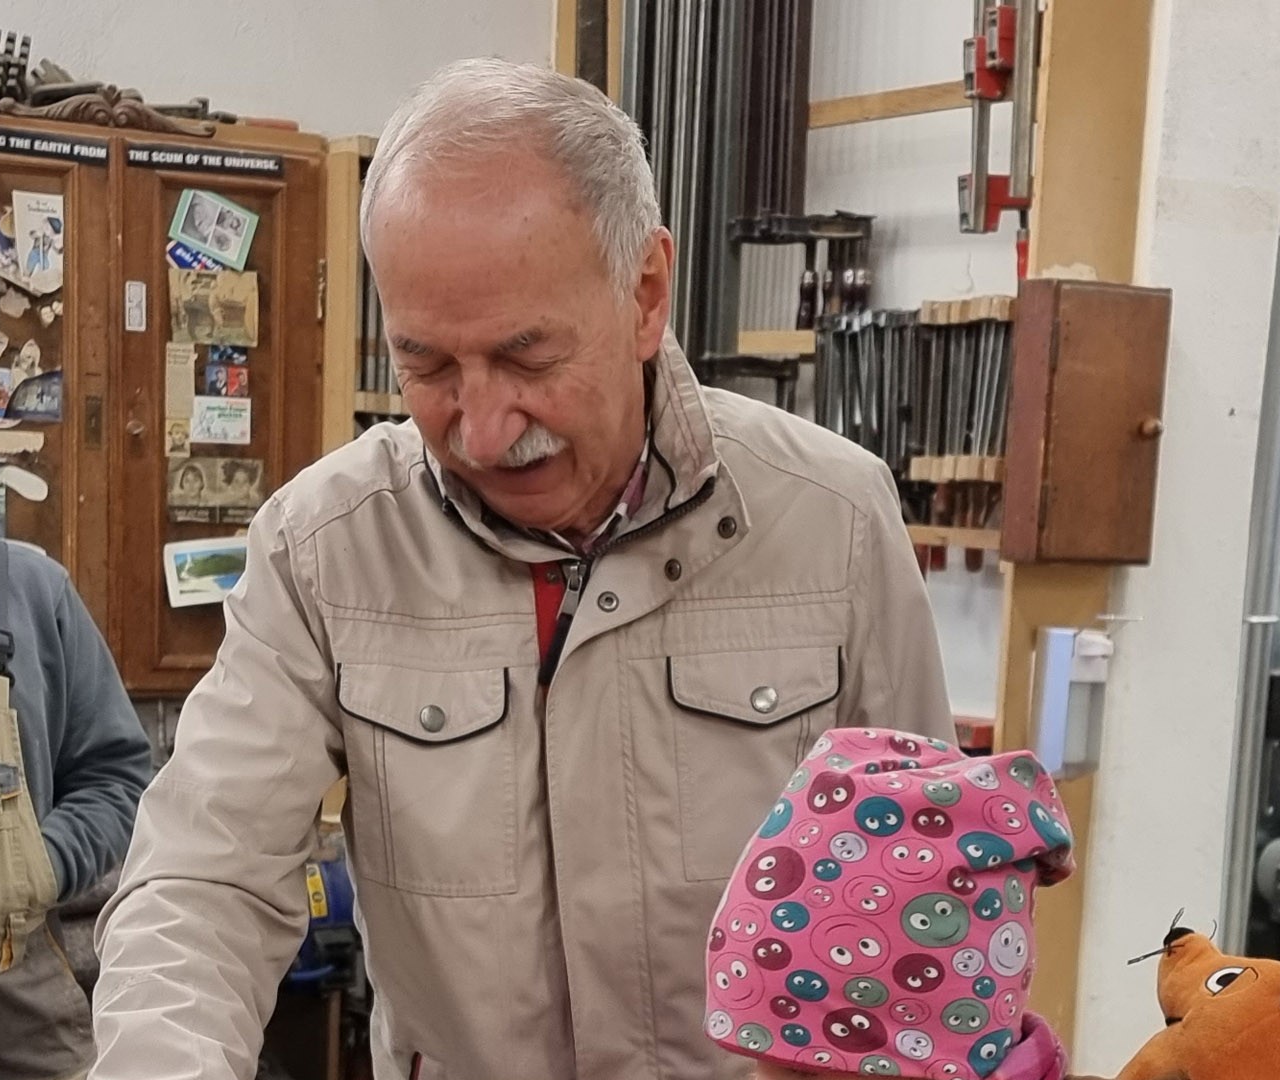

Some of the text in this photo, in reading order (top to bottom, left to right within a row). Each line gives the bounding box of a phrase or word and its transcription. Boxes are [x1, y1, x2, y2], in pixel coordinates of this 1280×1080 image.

[8, 137, 31, 150] THE
[33, 139, 71, 155] EARTH
[73, 144, 107, 158] FROM
[128, 150, 279, 170] THE SCUM OF THE UNIVERSE.
